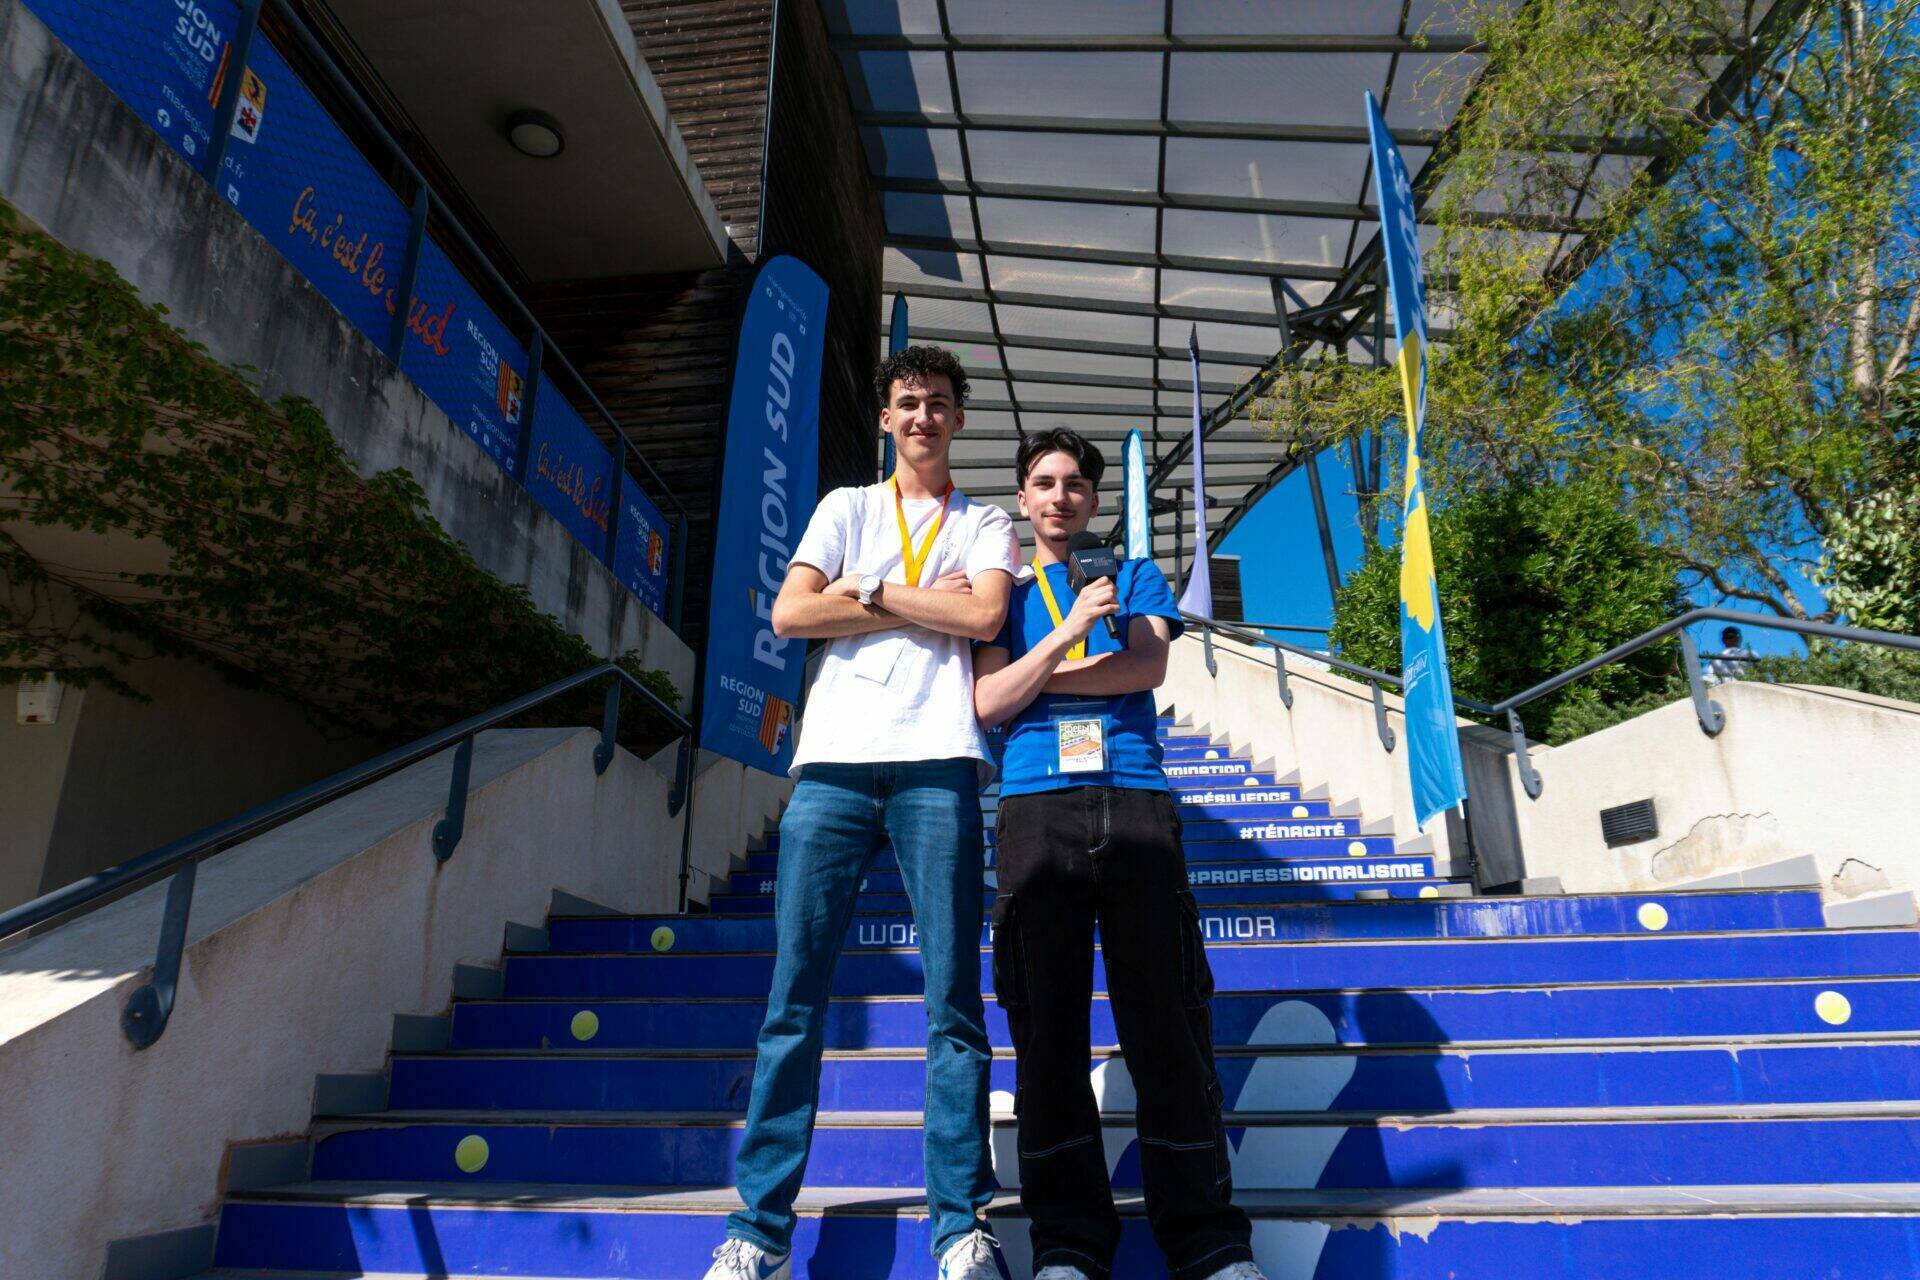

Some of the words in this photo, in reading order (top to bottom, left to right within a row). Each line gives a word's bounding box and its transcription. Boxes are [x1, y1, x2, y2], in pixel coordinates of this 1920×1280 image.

[176, 16, 215, 62] SUD
[320, 211, 368, 274] c'est
[362, 241, 385, 295] le
[480, 351, 497, 378] SUD
[765, 332, 795, 444] SUD
[737, 698, 761, 717] SUD
[1240, 822, 1345, 840] #TÉNACITÉ
[1187, 863, 1425, 885] #PROFESSIONNALISME
